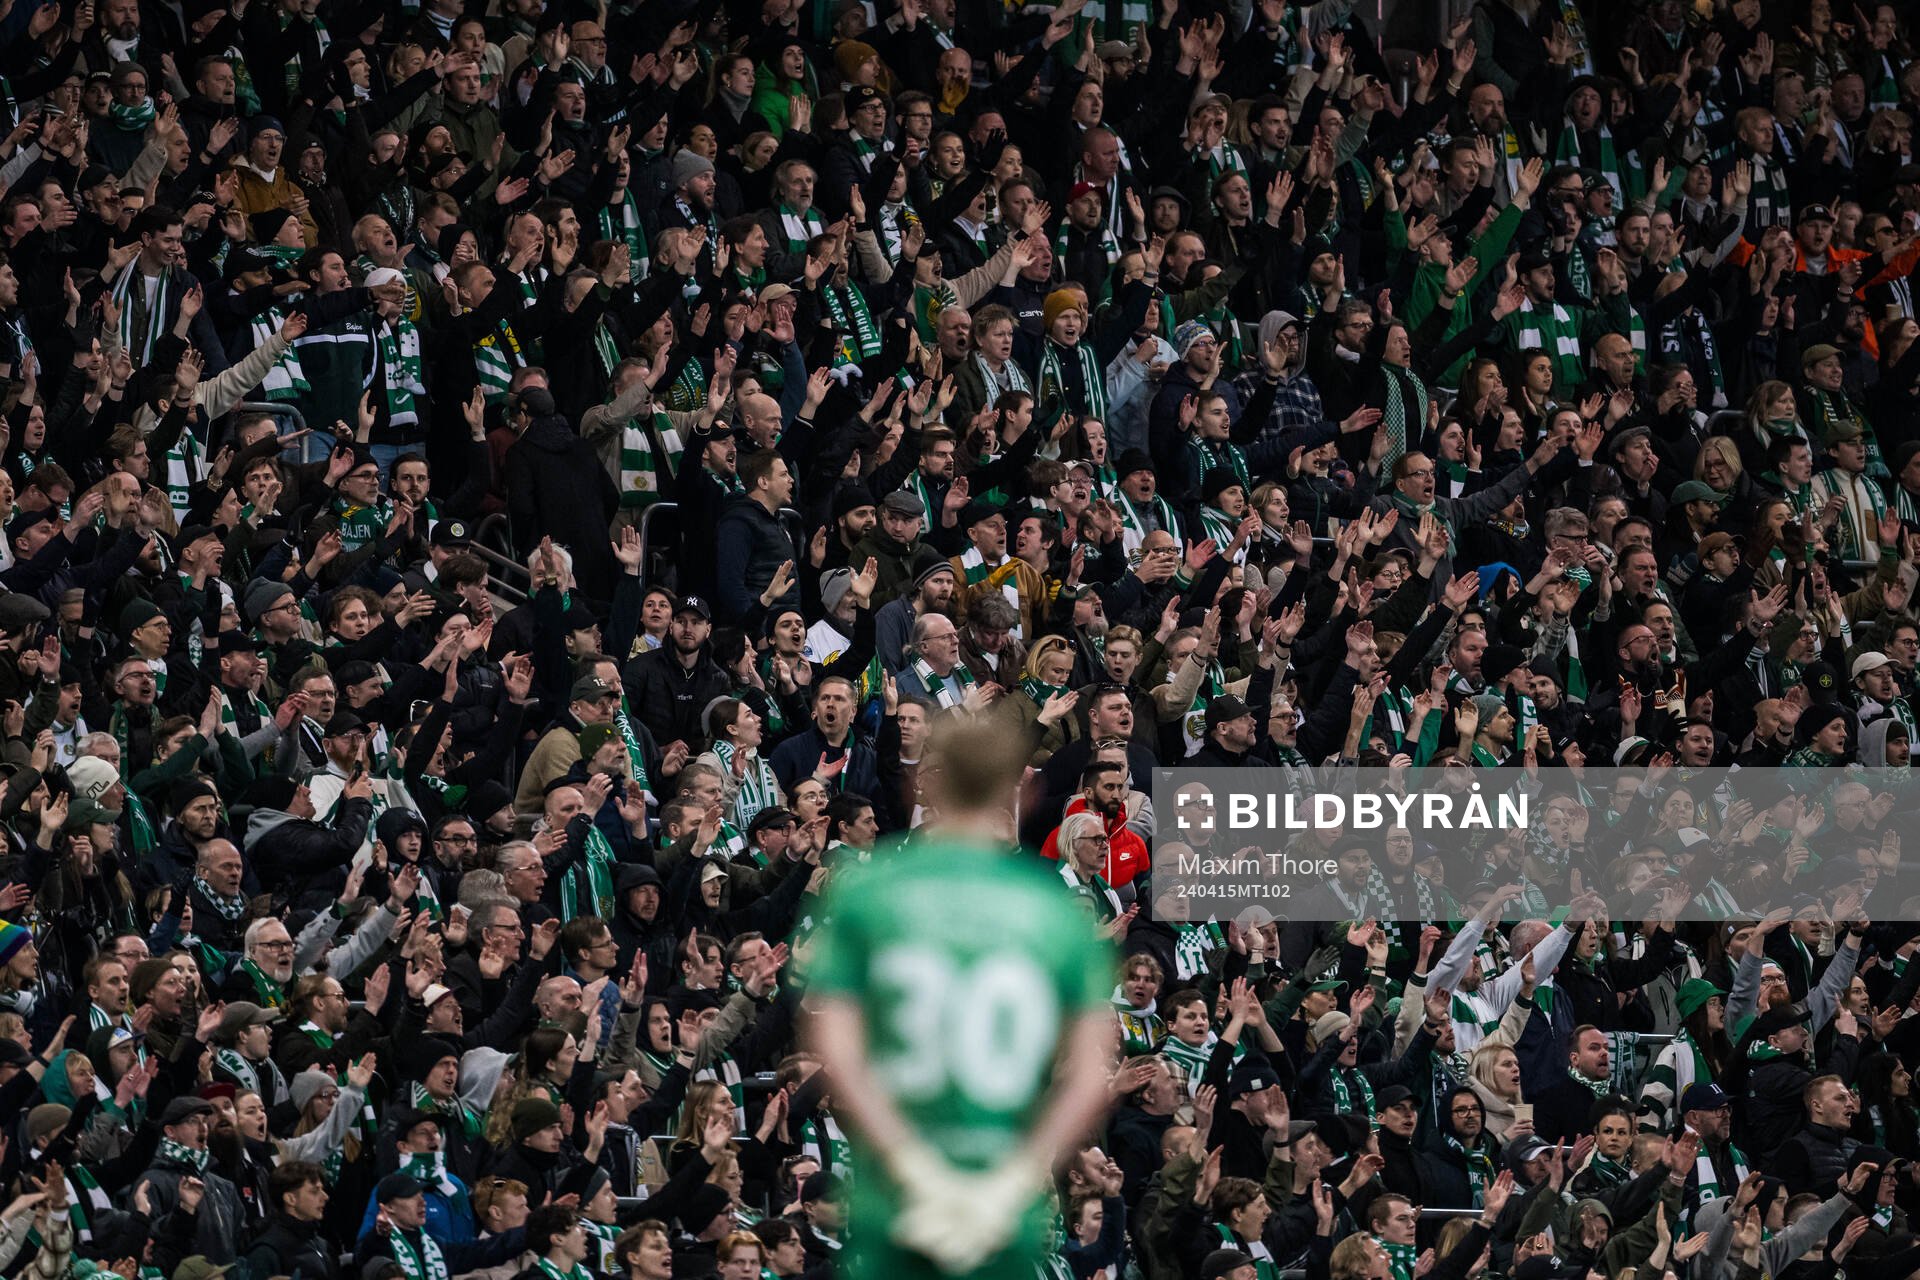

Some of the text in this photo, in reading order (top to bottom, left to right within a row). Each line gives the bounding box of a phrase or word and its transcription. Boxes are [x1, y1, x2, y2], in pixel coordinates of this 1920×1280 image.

[1019, 309, 1043, 318] carh
[341, 522, 371, 539] BAJEN
[867, 945, 1060, 1108] 30
